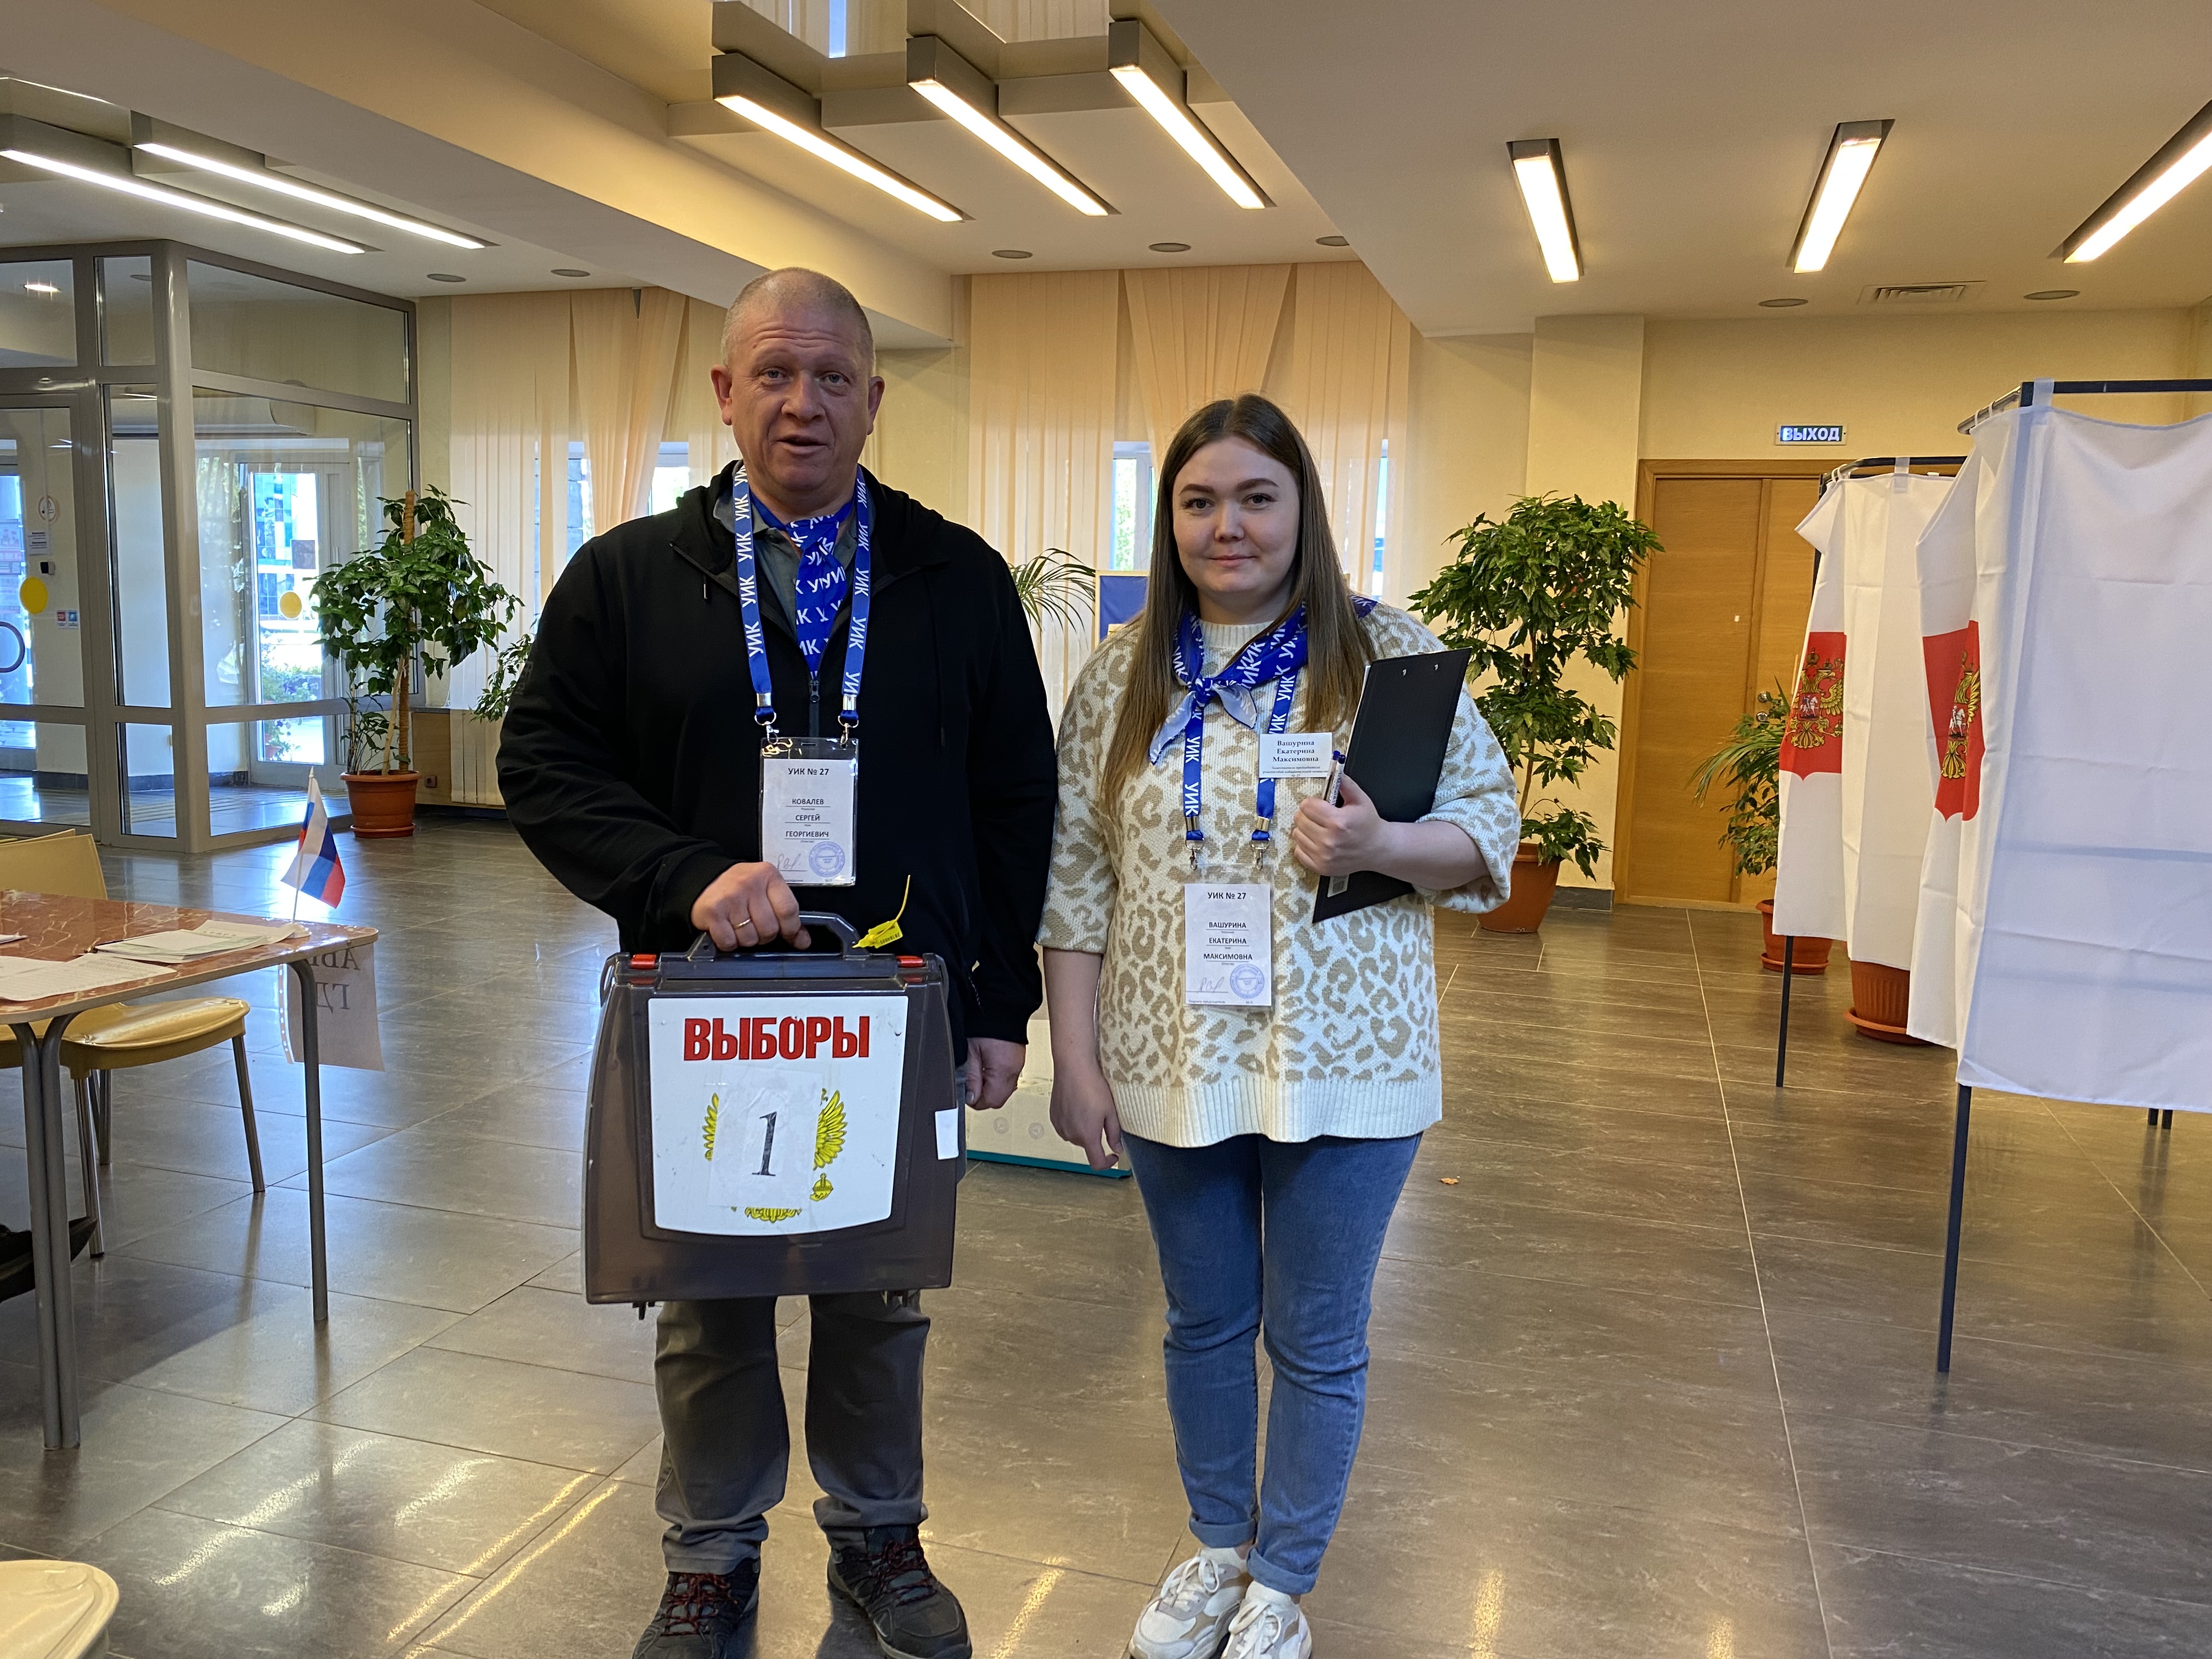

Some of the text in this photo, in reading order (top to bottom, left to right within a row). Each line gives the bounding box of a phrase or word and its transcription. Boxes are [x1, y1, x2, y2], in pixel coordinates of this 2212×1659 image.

[1782, 427, 1839, 441] ВЫХОД
[734, 494, 750, 521] УИК
[736, 531, 753, 562] УИК
[739, 574, 756, 607] УИК
[843, 478, 869, 694] УИК УИК УИК УИК УИ
[744, 620, 764, 657] УИК
[1277, 675, 1295, 701] УИК
[1185, 736, 1200, 763] УИК
[1185, 782, 1199, 816] УИК
[683, 1015, 870, 1061] ВЫБОРЫ
[752, 1111, 778, 1177] 1
